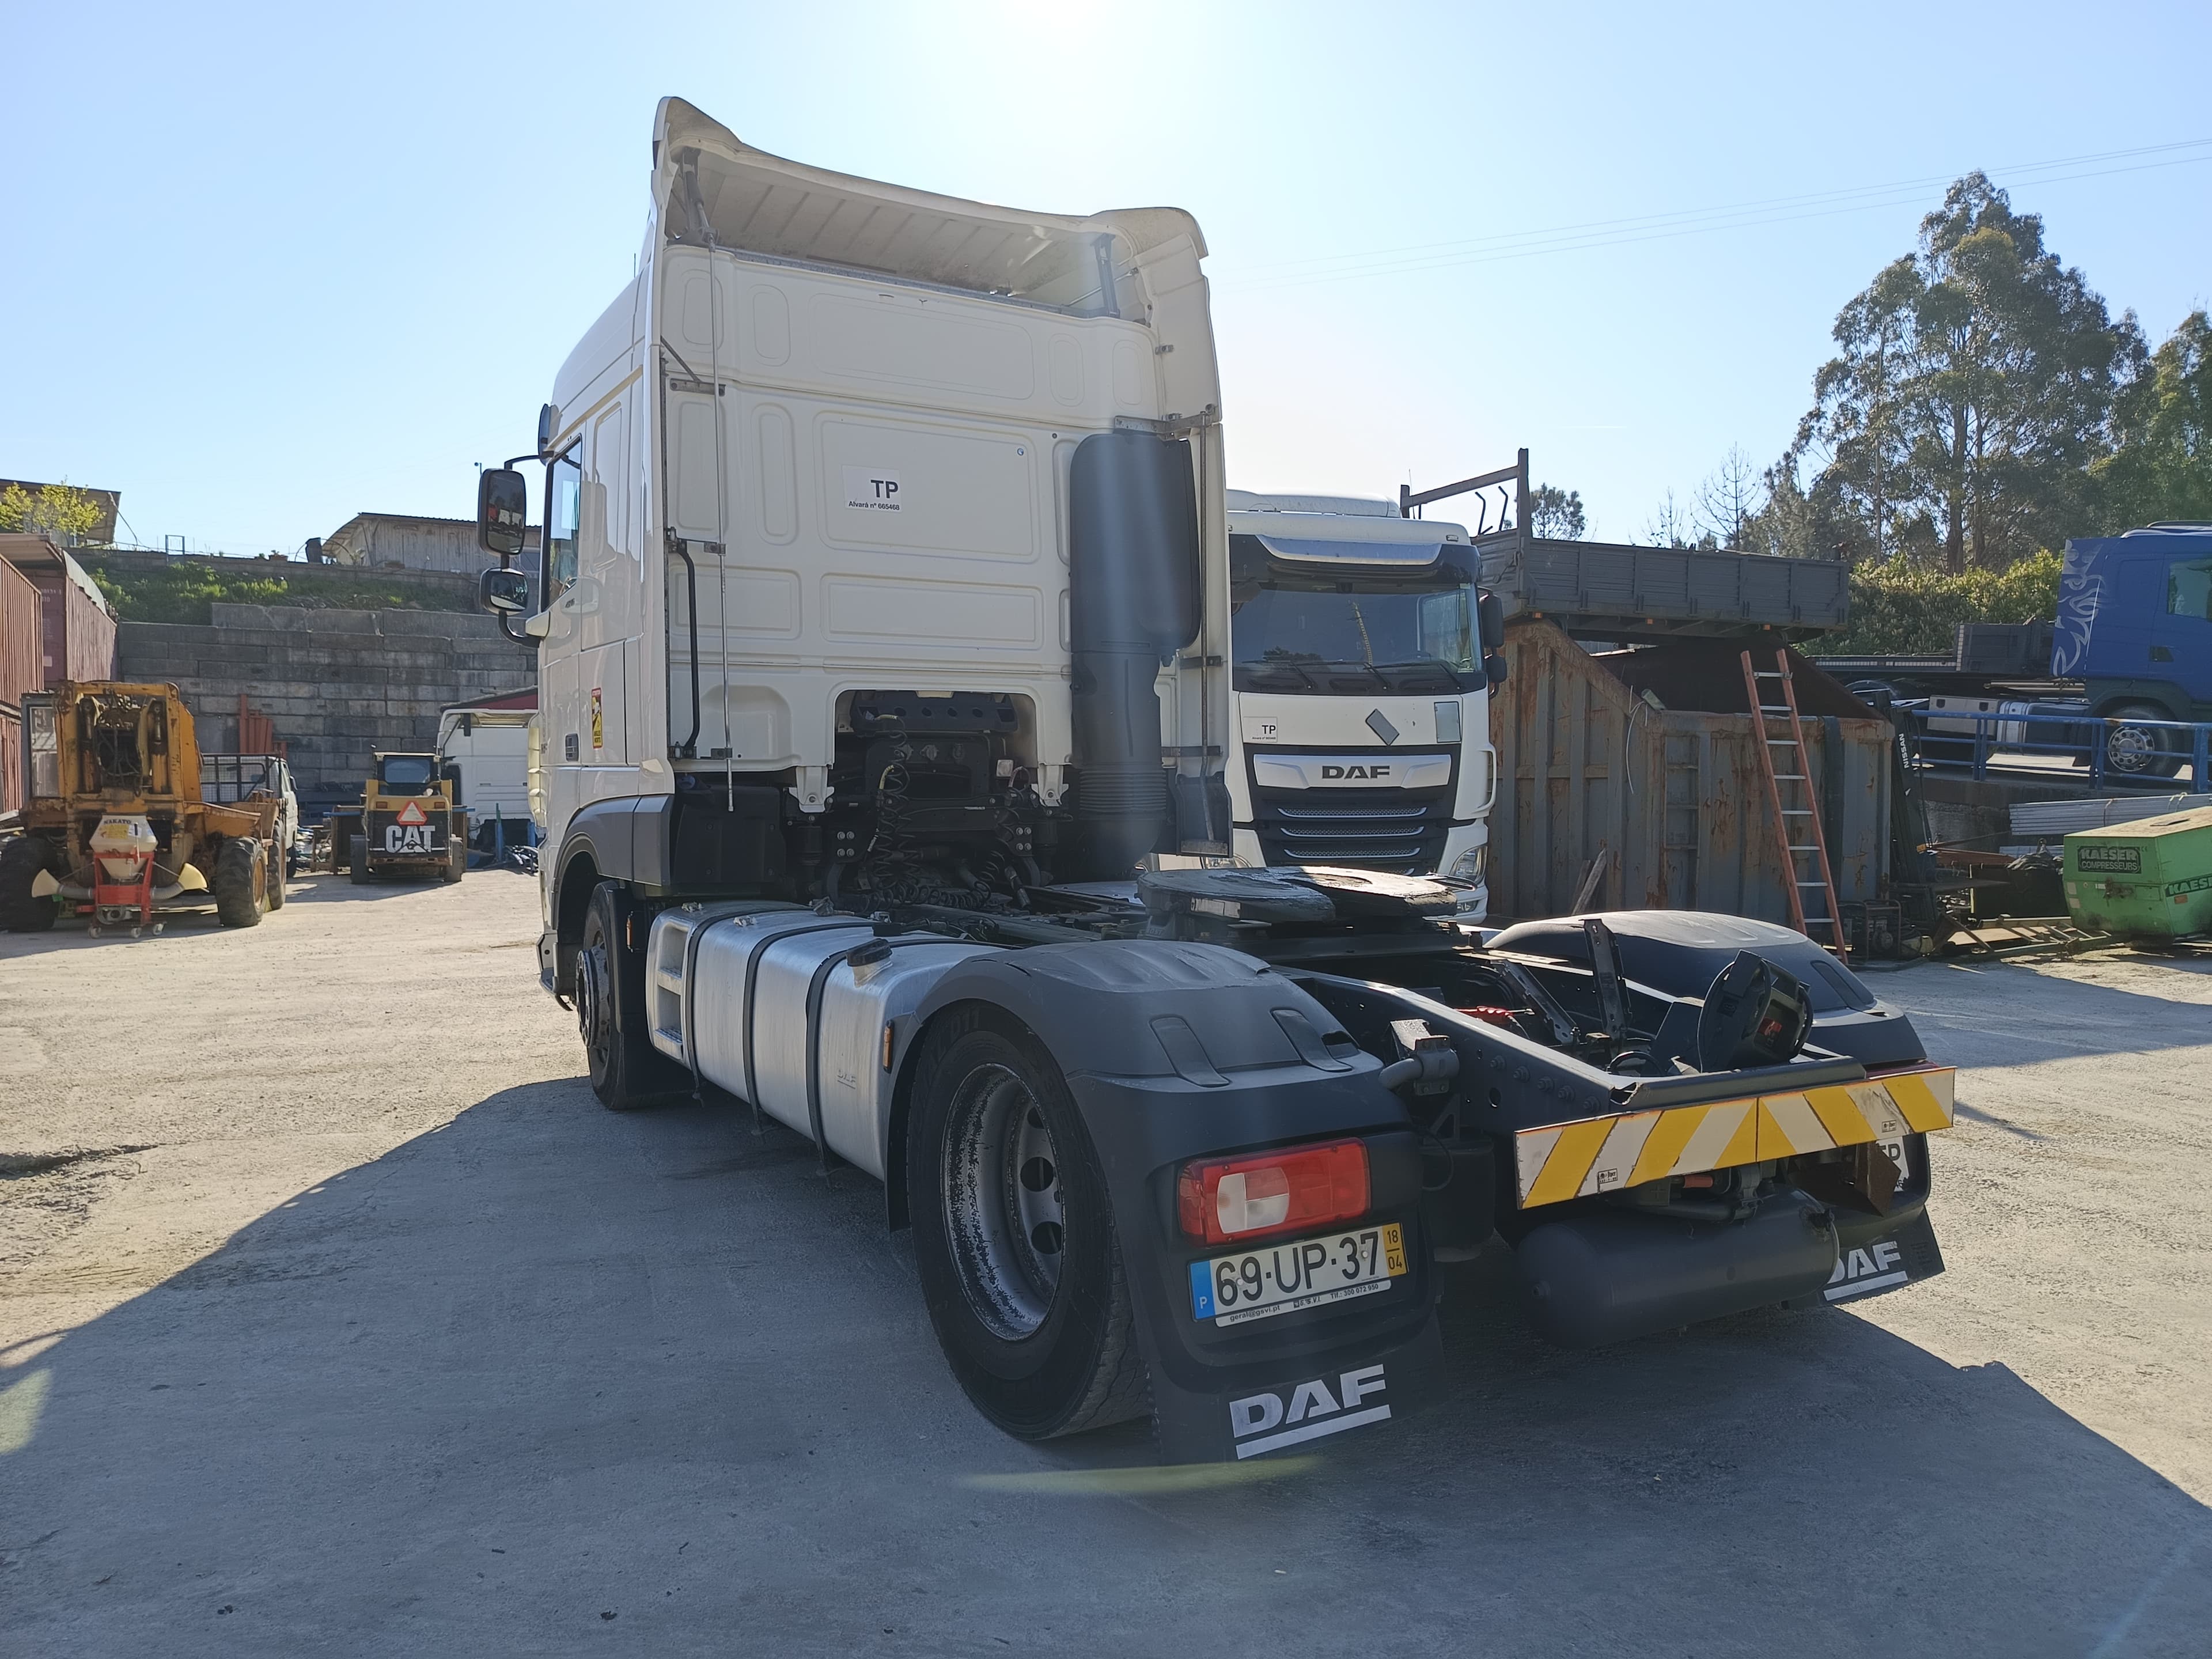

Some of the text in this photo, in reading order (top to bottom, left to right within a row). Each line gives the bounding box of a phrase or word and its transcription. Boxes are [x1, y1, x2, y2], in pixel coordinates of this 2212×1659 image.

[870, 479, 899, 498] TP
[849, 500, 869, 509] Alvará
[1262, 725, 1276, 734] TP
[1899, 733, 1910, 768] NISSAN
[1322, 766, 1390, 779] DAF
[386, 825, 435, 853] CAT
[2081, 849, 2137, 861] KAESER
[2081, 861, 2138, 871] COMPRESSEURS
[1387, 1229, 1399, 1244] 18
[1388, 1255, 1402, 1270] 04
[1356, 1286, 1368, 1294] 072
[1199, 1297, 1207, 1309] P
[1230, 1305, 1281, 1322] geral@gsvi.pt
[1229, 1363, 1386, 1438] DAF
